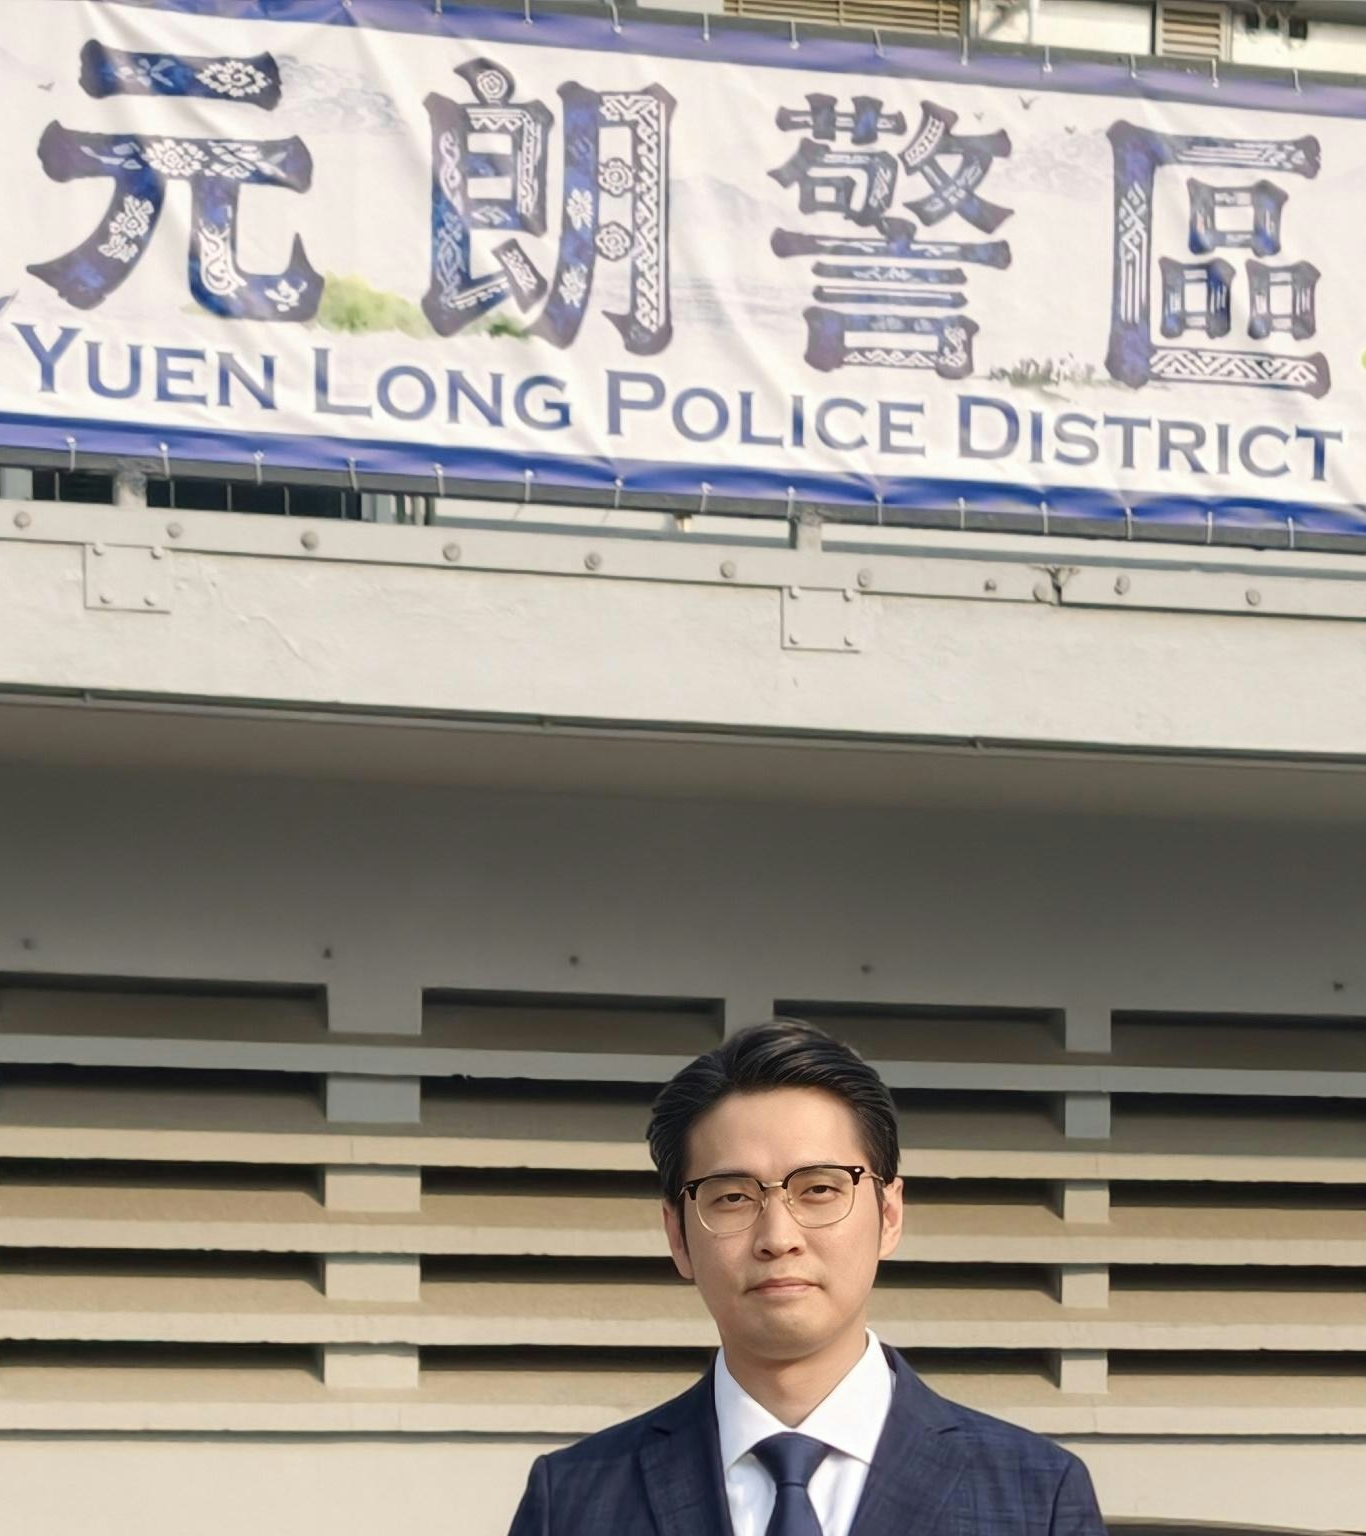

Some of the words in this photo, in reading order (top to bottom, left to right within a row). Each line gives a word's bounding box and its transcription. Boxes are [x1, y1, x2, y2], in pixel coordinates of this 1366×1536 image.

[27, 39, 1330, 399] 元朗警區
[11, 322, 280, 411] YUEN
[311, 347, 573, 431] LONG
[606, 370, 927, 456] POLICE
[958, 394, 1343, 482] DISTRICT
